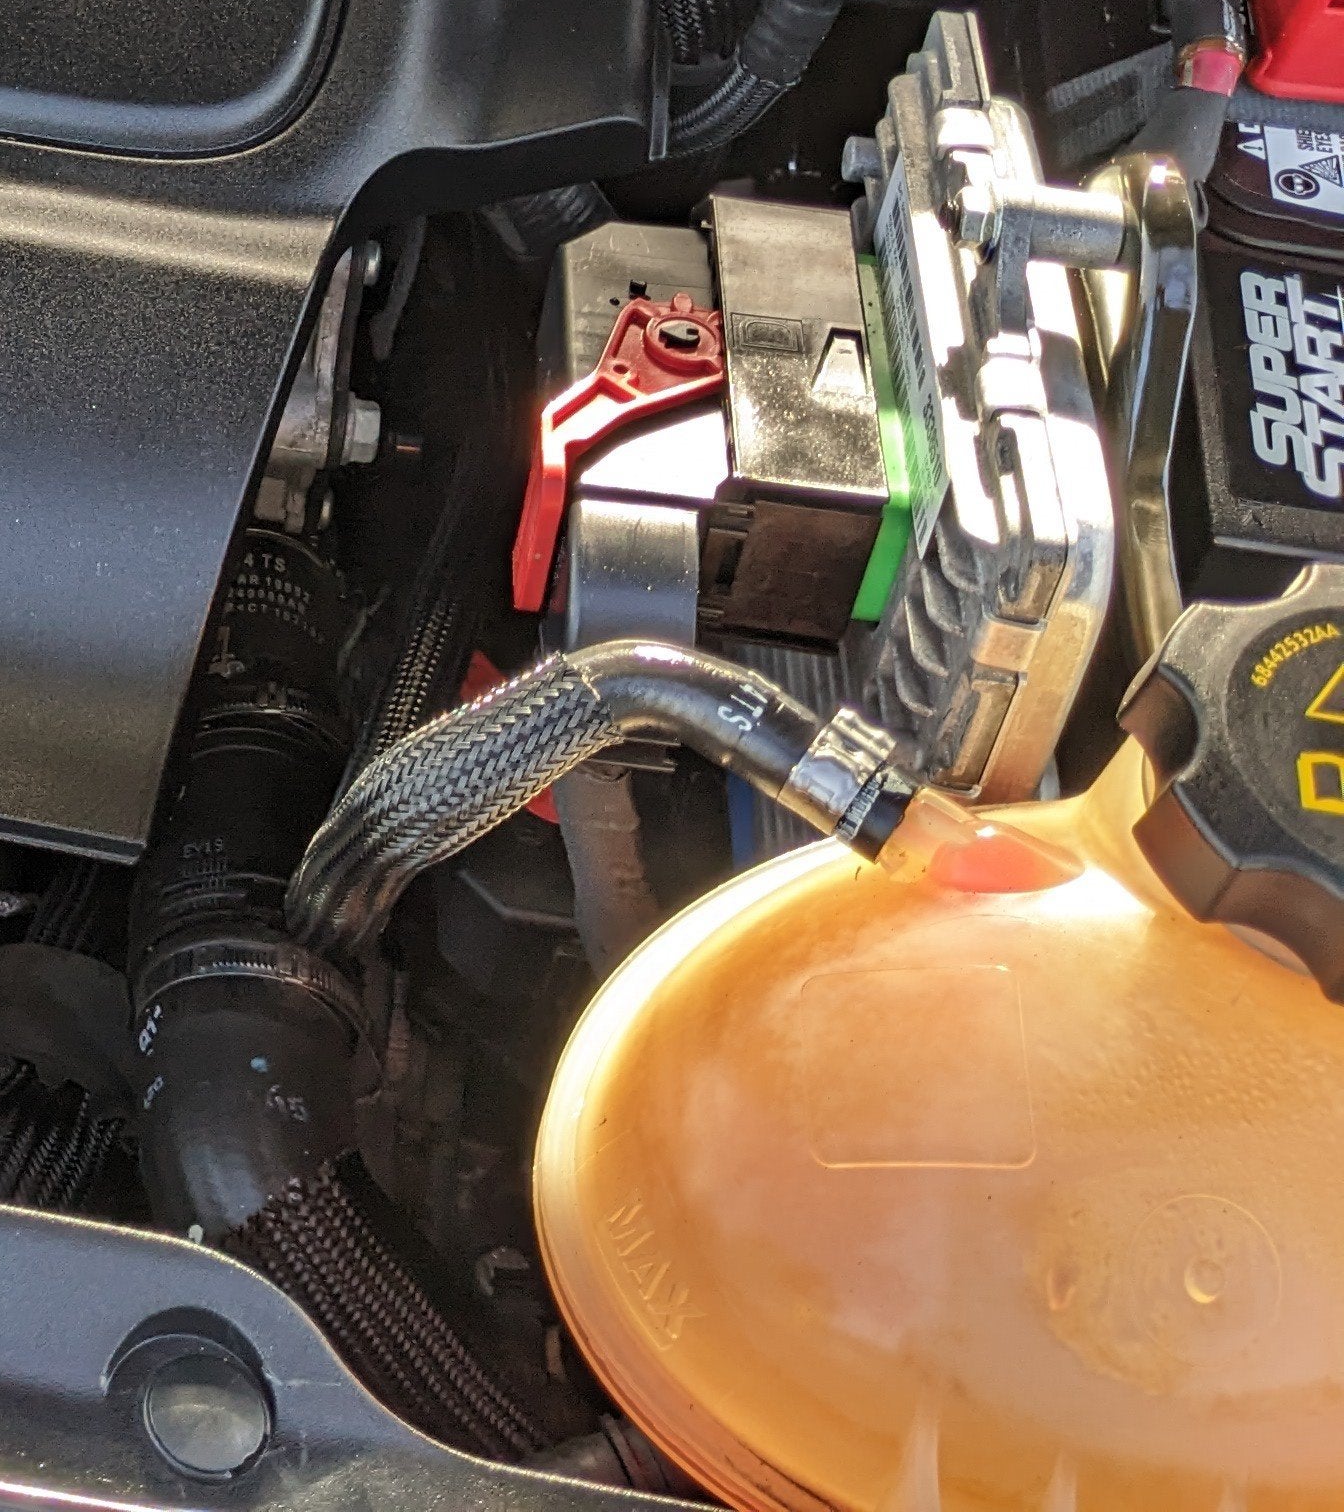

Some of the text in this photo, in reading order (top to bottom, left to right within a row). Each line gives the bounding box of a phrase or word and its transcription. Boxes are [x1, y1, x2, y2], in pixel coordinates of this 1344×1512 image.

[1240, 271, 1307, 474] SUPER
[1283, 270, 1344, 498] START
[1250, 623, 1340, 687] 68442532AA
[606, 1203, 710, 1340] MAX
